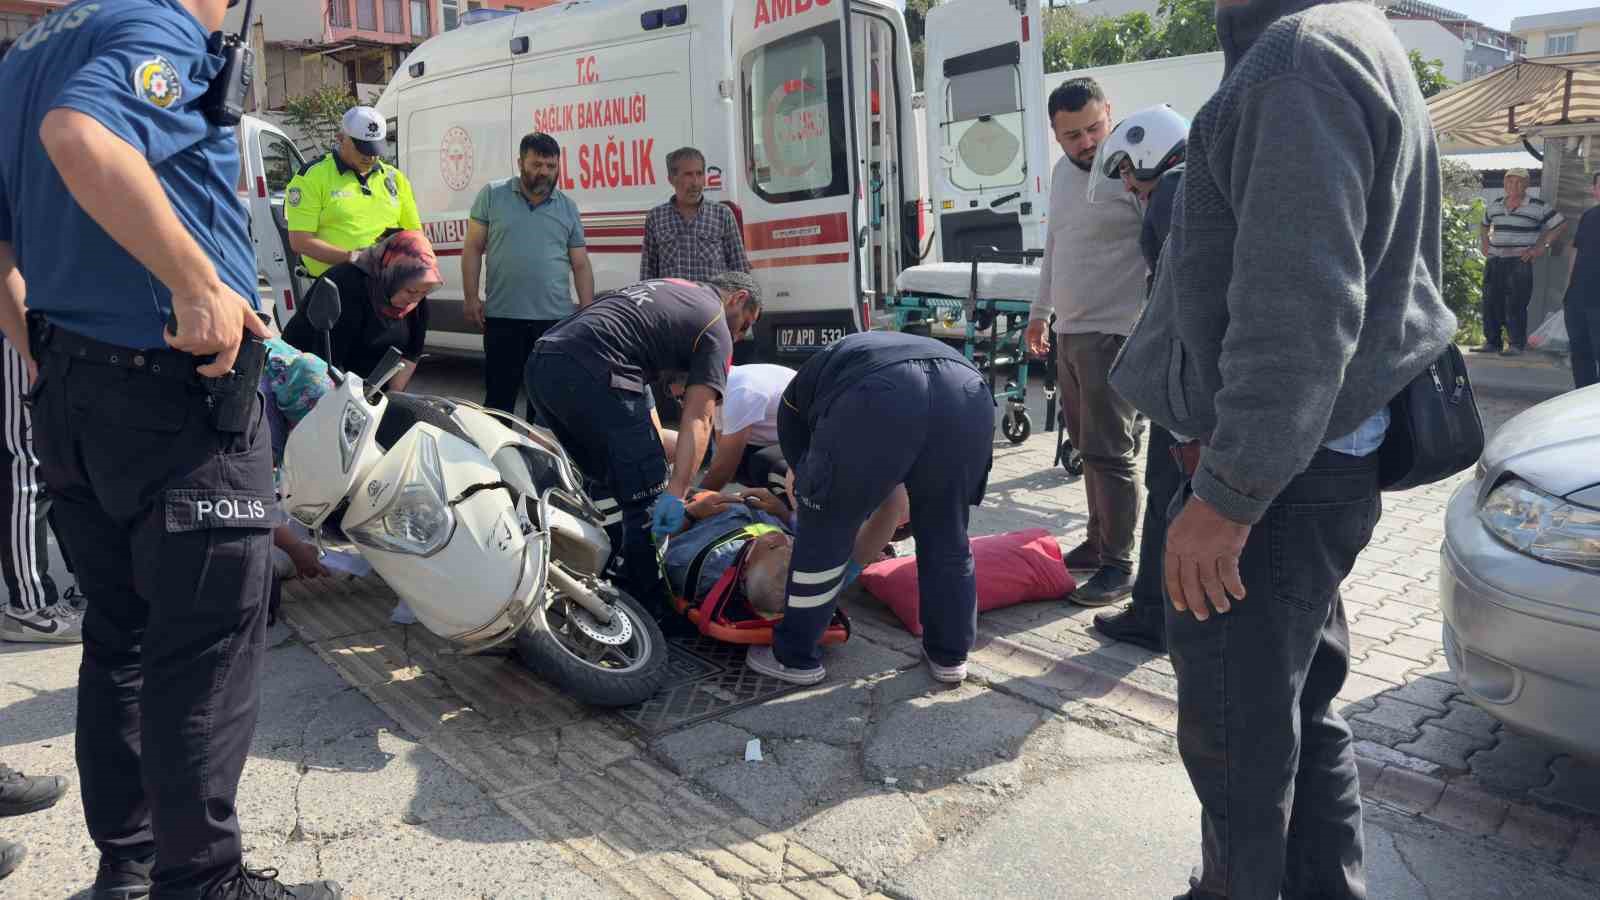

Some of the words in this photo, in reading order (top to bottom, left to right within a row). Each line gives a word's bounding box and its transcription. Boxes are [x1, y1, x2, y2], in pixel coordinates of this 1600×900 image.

[576, 56, 599, 84] T.C.
[534, 103, 573, 133] SAĞLIK
[577, 91, 646, 130] BAKANLIĞI
[579, 135, 656, 190] SAĞLIK
[781, 329, 793, 345] 07
